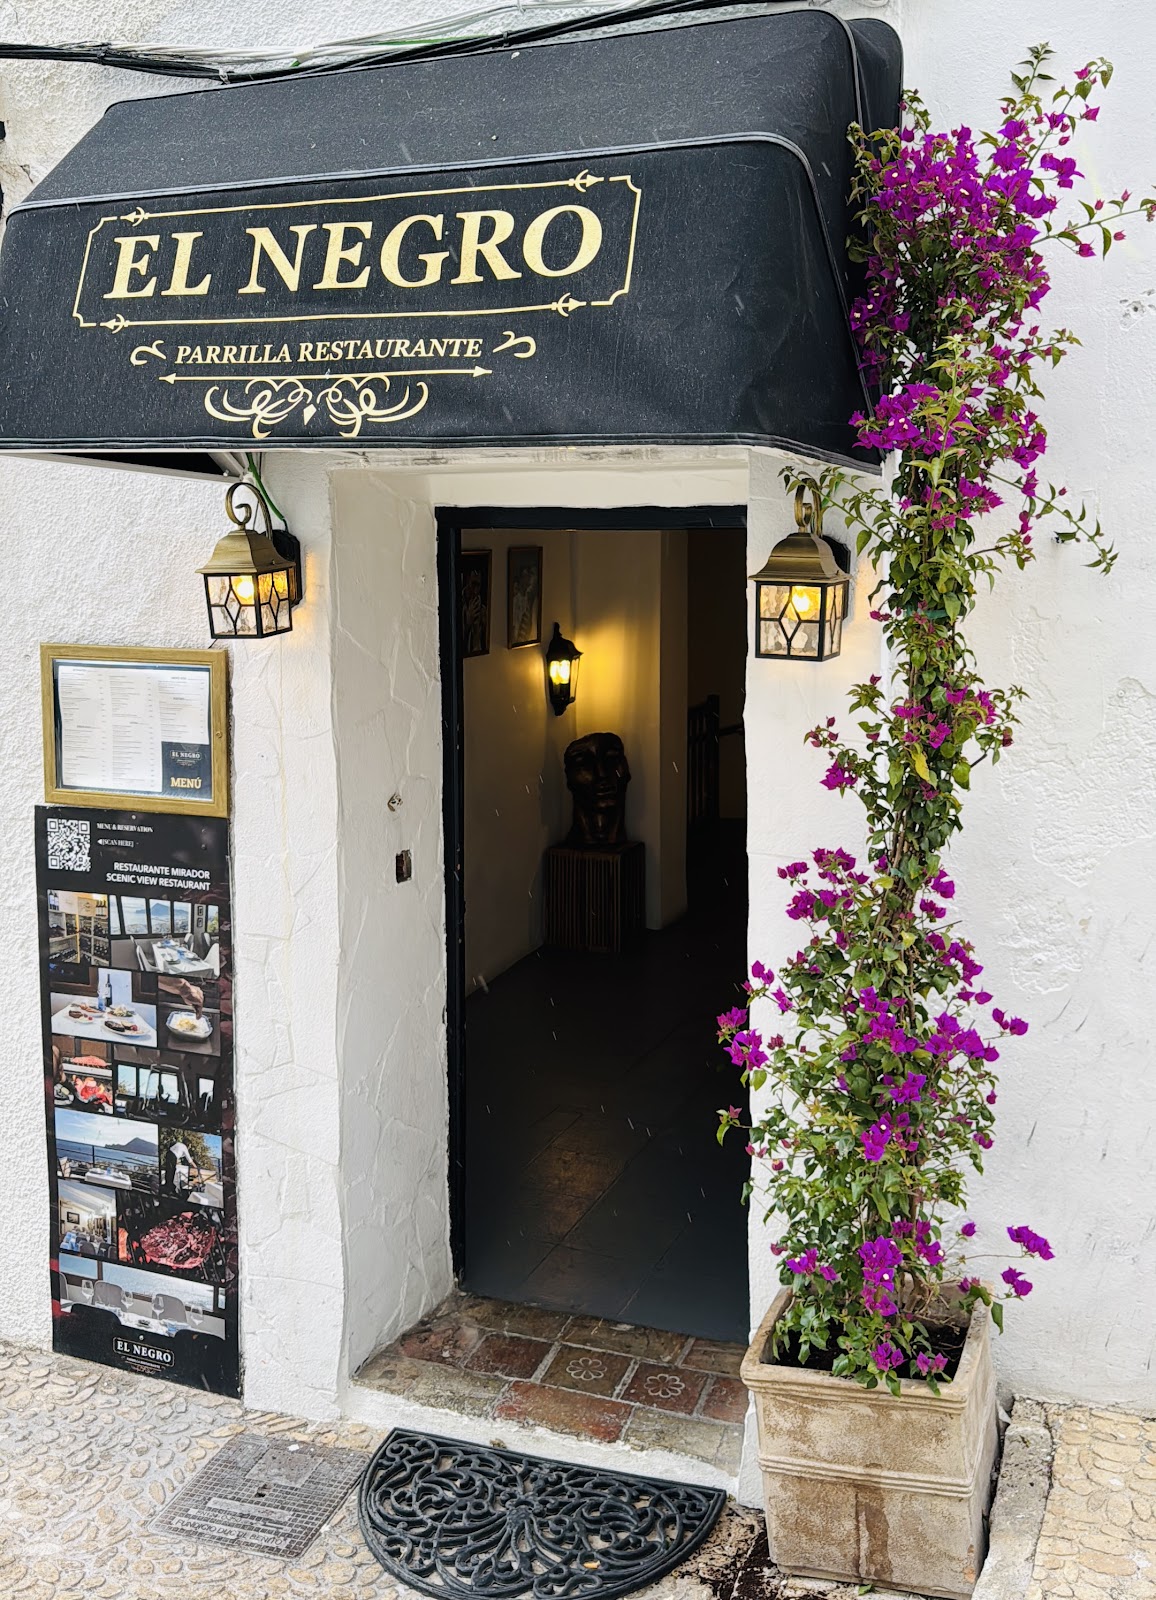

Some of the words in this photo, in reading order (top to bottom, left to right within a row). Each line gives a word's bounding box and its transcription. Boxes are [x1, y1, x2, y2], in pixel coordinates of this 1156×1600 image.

[103, 231, 212, 299] EL
[237, 204, 603, 294] NEGRO
[174, 343, 293, 364] PARRILLA
[297, 338, 484, 363] RESTAURANTE
[170, 777, 202, 789] MENÚ
[117, 823, 154, 833] RESERVATION
[113, 862, 170, 876] RESTAURANTE
[171, 867, 211, 880] MIRADOR
[106, 872, 137, 884] SCENIC
[136, 875, 159, 886] VIEW
[158, 877, 211, 892] RESTAURANT
[117, 1340, 131, 1353] EL
[132, 1344, 171, 1363] NEGRO
